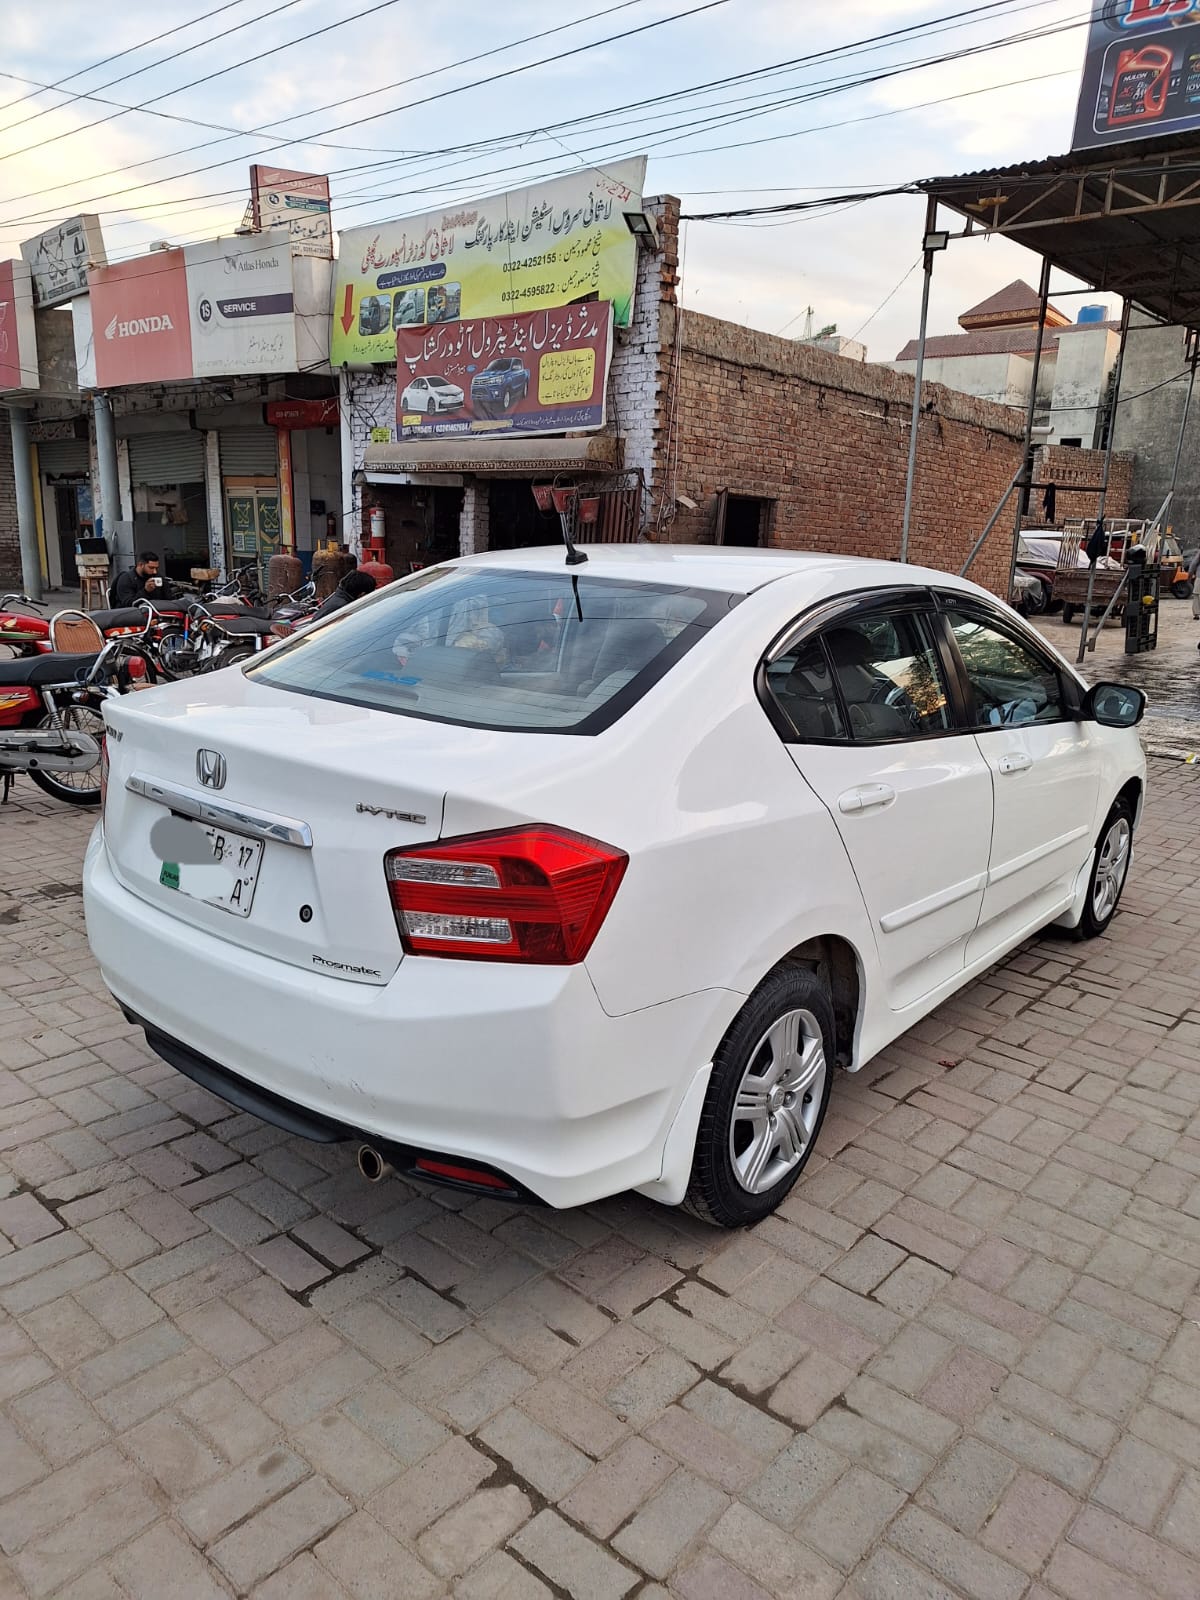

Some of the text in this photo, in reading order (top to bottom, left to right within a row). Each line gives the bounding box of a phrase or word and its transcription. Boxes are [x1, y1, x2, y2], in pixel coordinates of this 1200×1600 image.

[238, 257, 279, 272] Atlas Honda
[502, 252, 557, 273] 0322-4252155
[223, 302, 257, 314] SERVICE
[118, 313, 174, 338] HONDA
[238, 846, 254, 870] 17
[229, 878, 242, 906] A
[311, 953, 382, 978] Prosmatec
